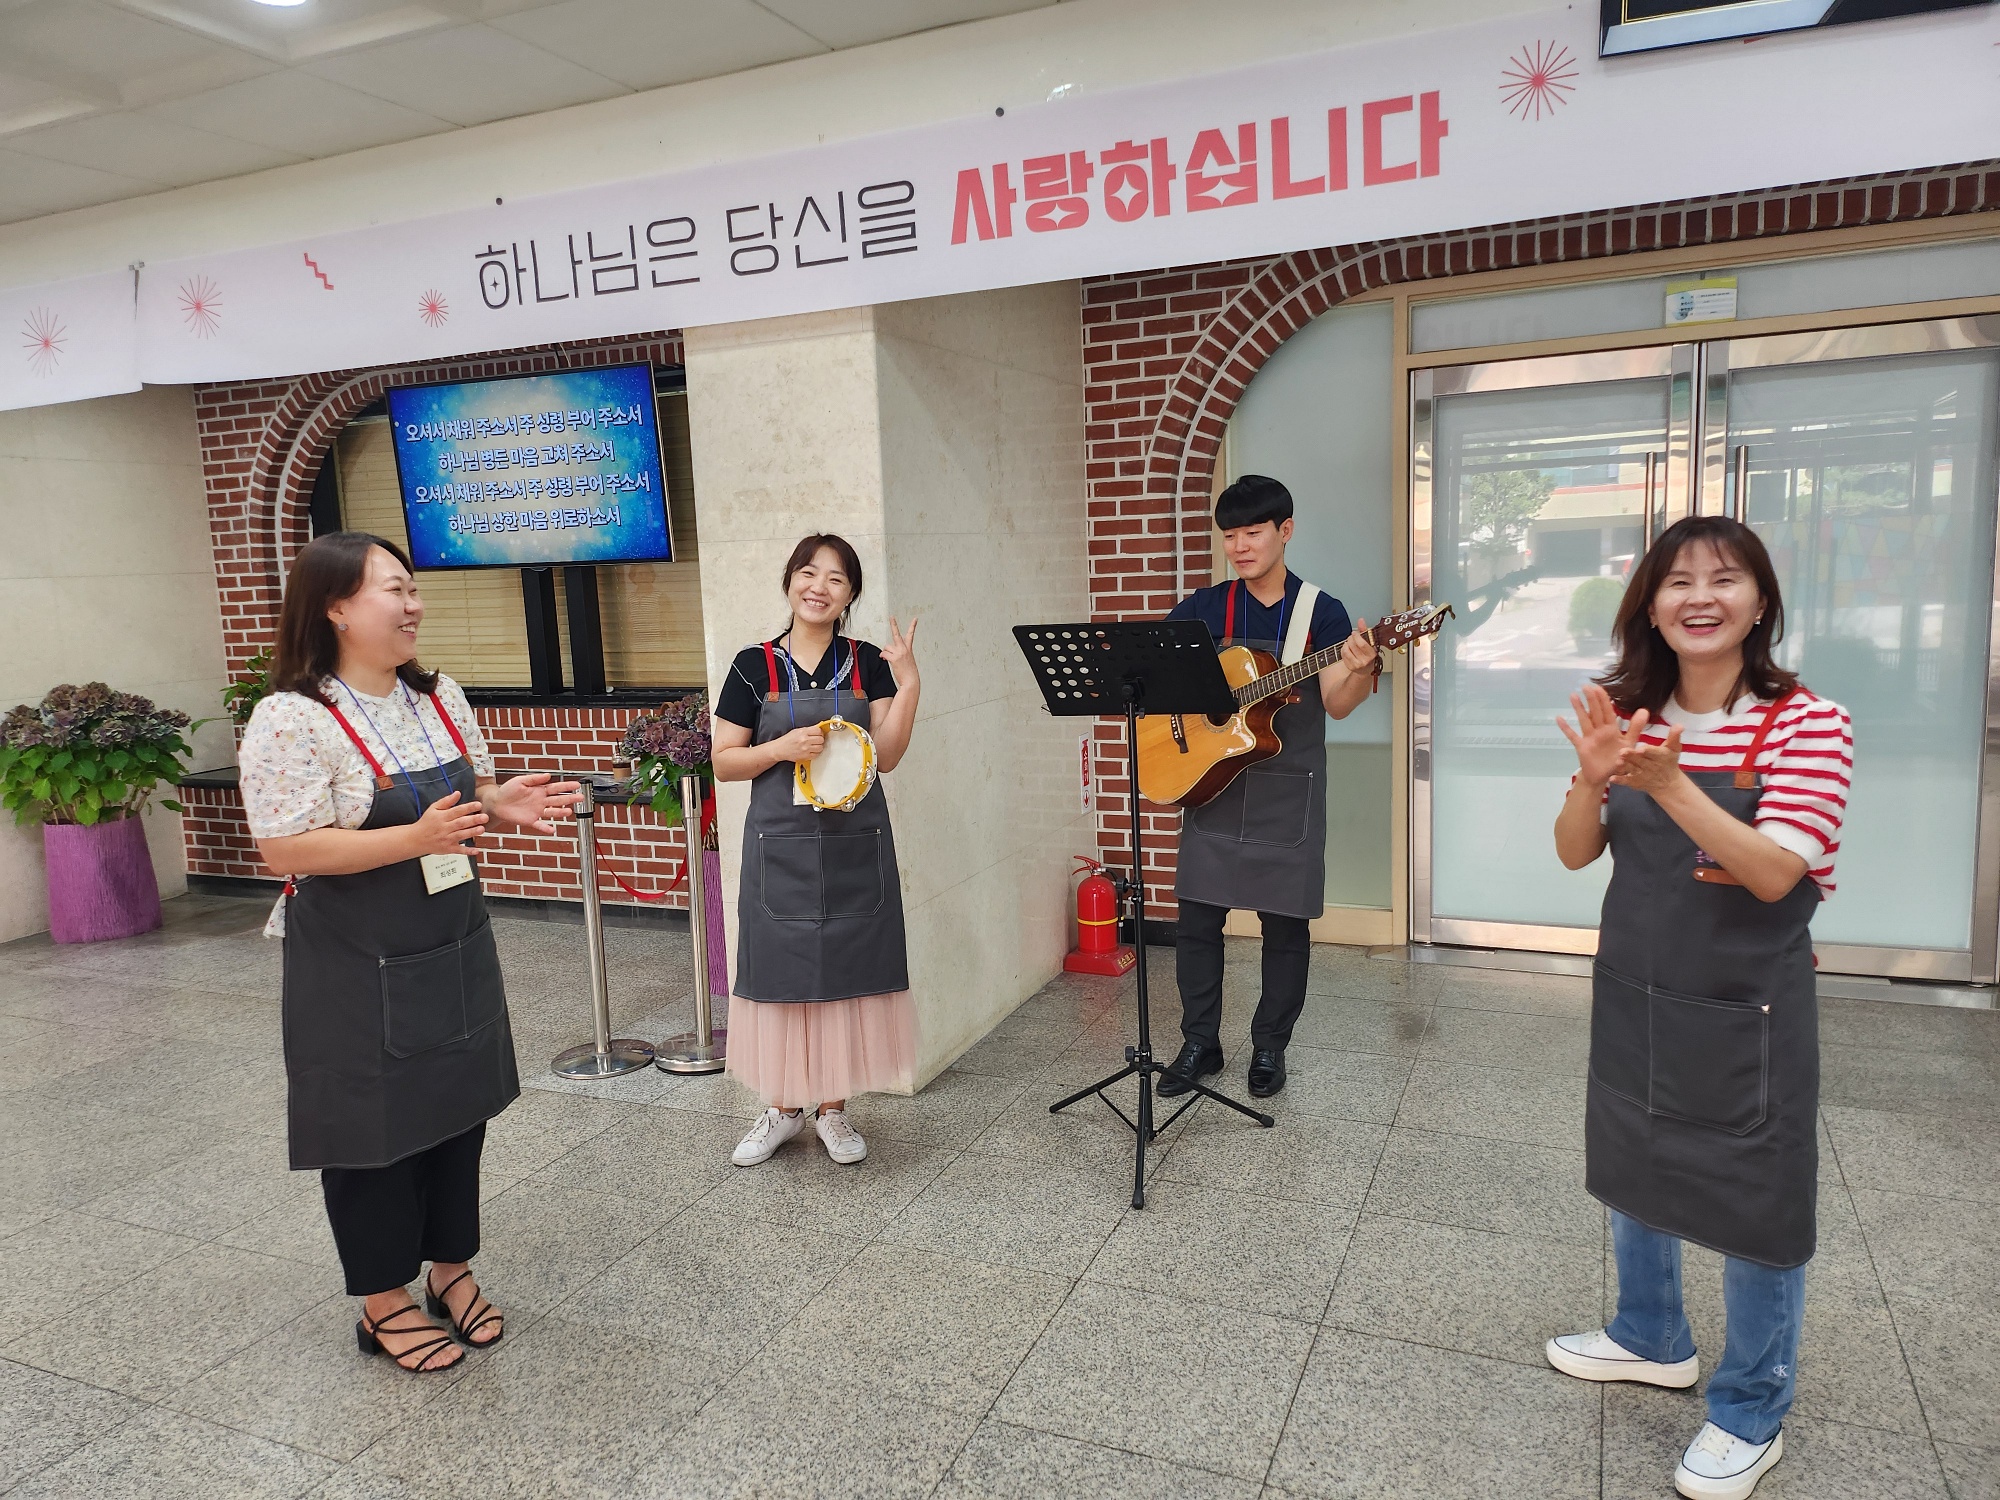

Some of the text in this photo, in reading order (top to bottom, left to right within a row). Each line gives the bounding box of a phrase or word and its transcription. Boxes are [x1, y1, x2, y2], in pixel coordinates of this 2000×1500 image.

[475, 90, 1449, 309] 하나님은 당신을 사랑하십니다
[407, 404, 643, 442] 오셔서 채워 주소서 주 성령 부어 주소서
[438, 440, 615, 473] 하나님 병든 마음 고쳐 주소서
[415, 470, 651, 504] 오셔서 채워 주소서 주 성령 부어 주소서
[448, 505, 622, 534] 하나님 상한 마음 위로하소서
